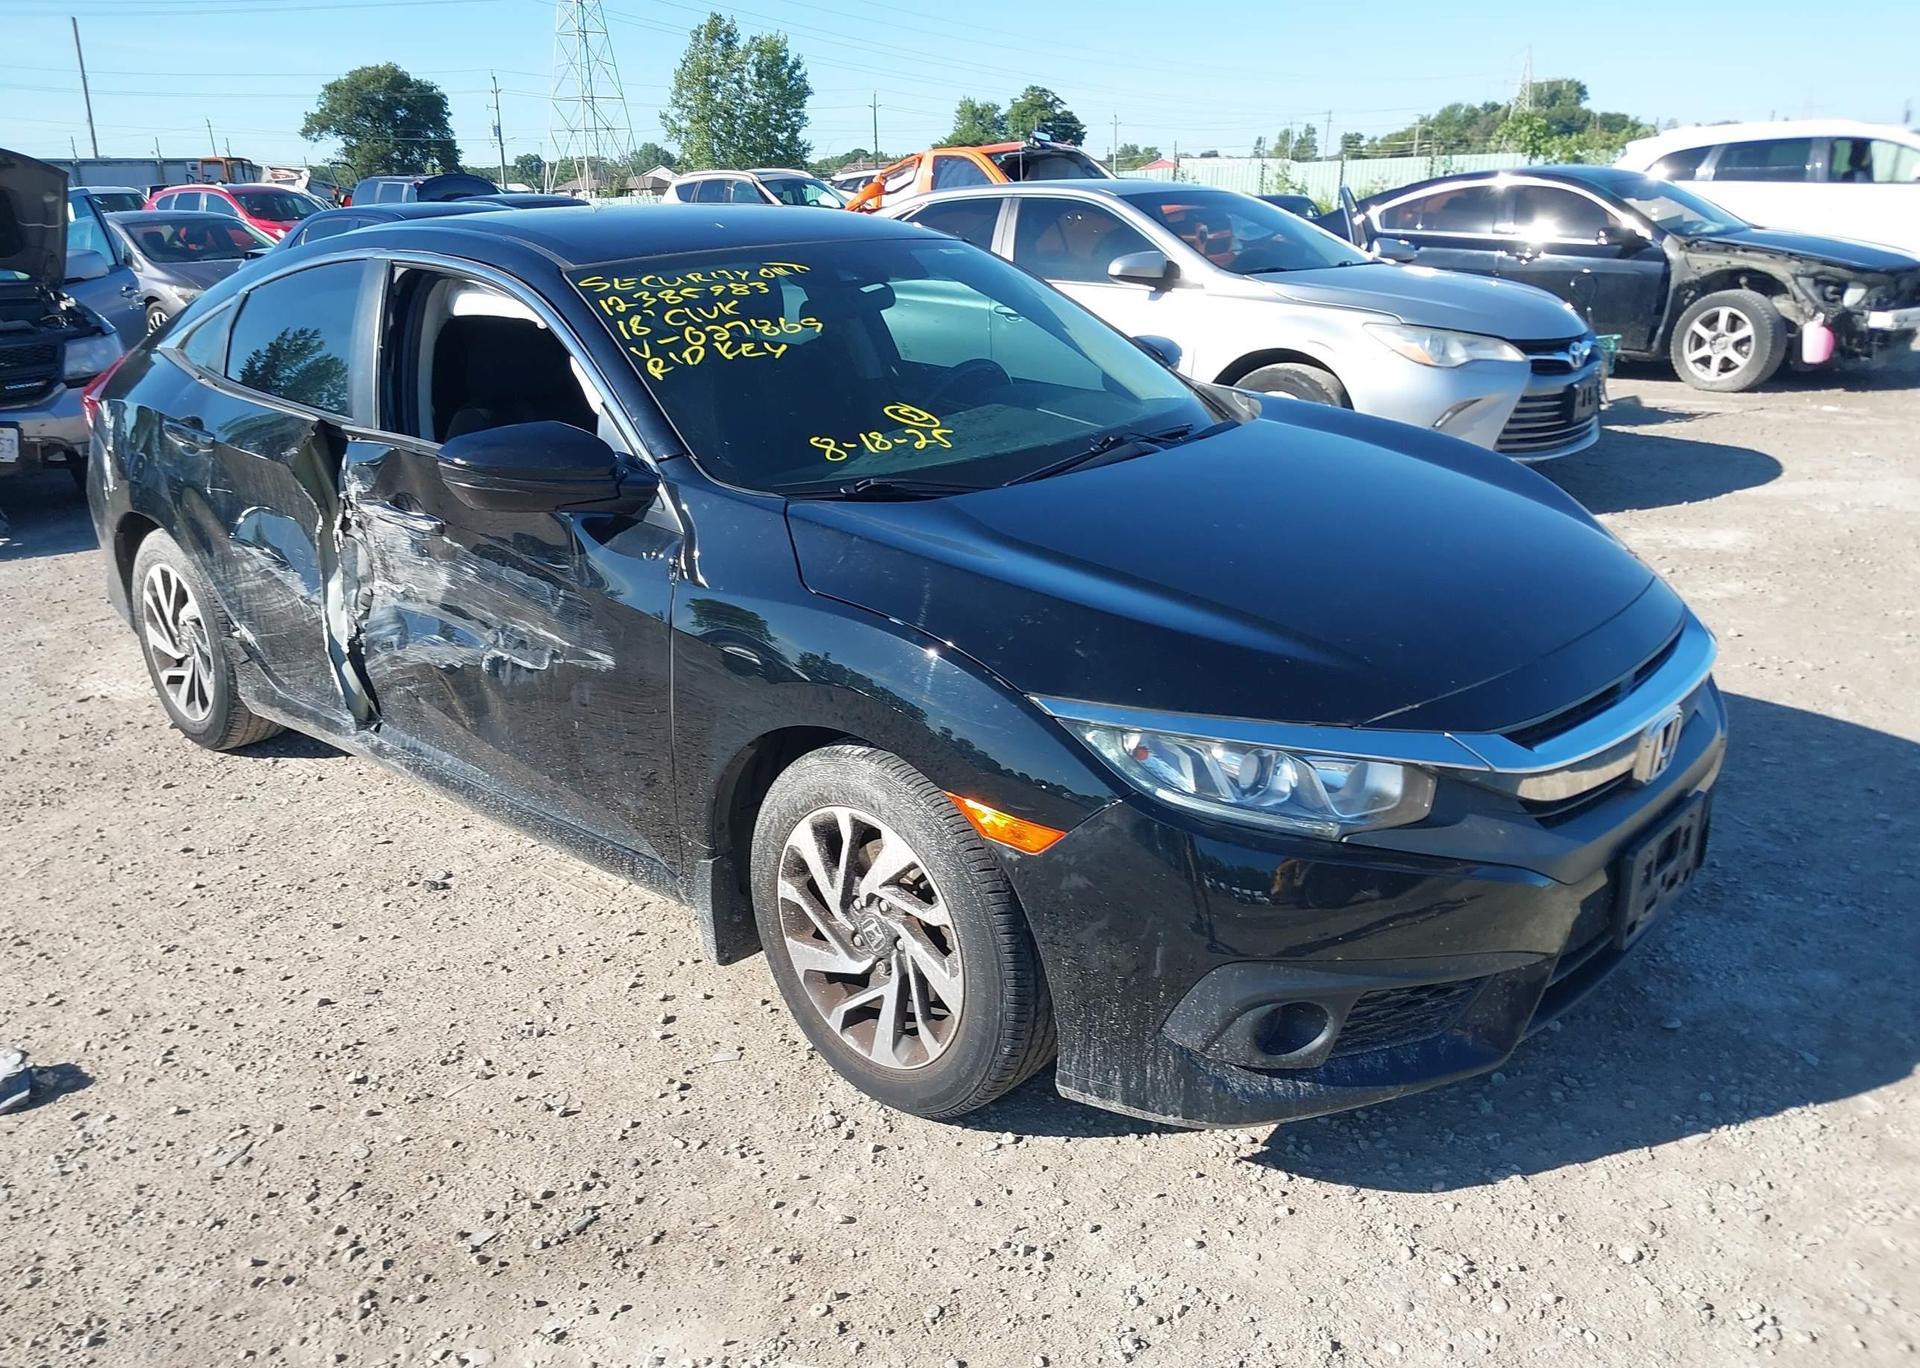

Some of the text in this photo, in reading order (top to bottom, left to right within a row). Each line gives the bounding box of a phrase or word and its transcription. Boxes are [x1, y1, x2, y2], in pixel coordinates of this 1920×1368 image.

[578, 269, 750, 292] SECURITY
[714, 341, 788, 360] KEY
[809, 429, 954, 461] 8-18-25
